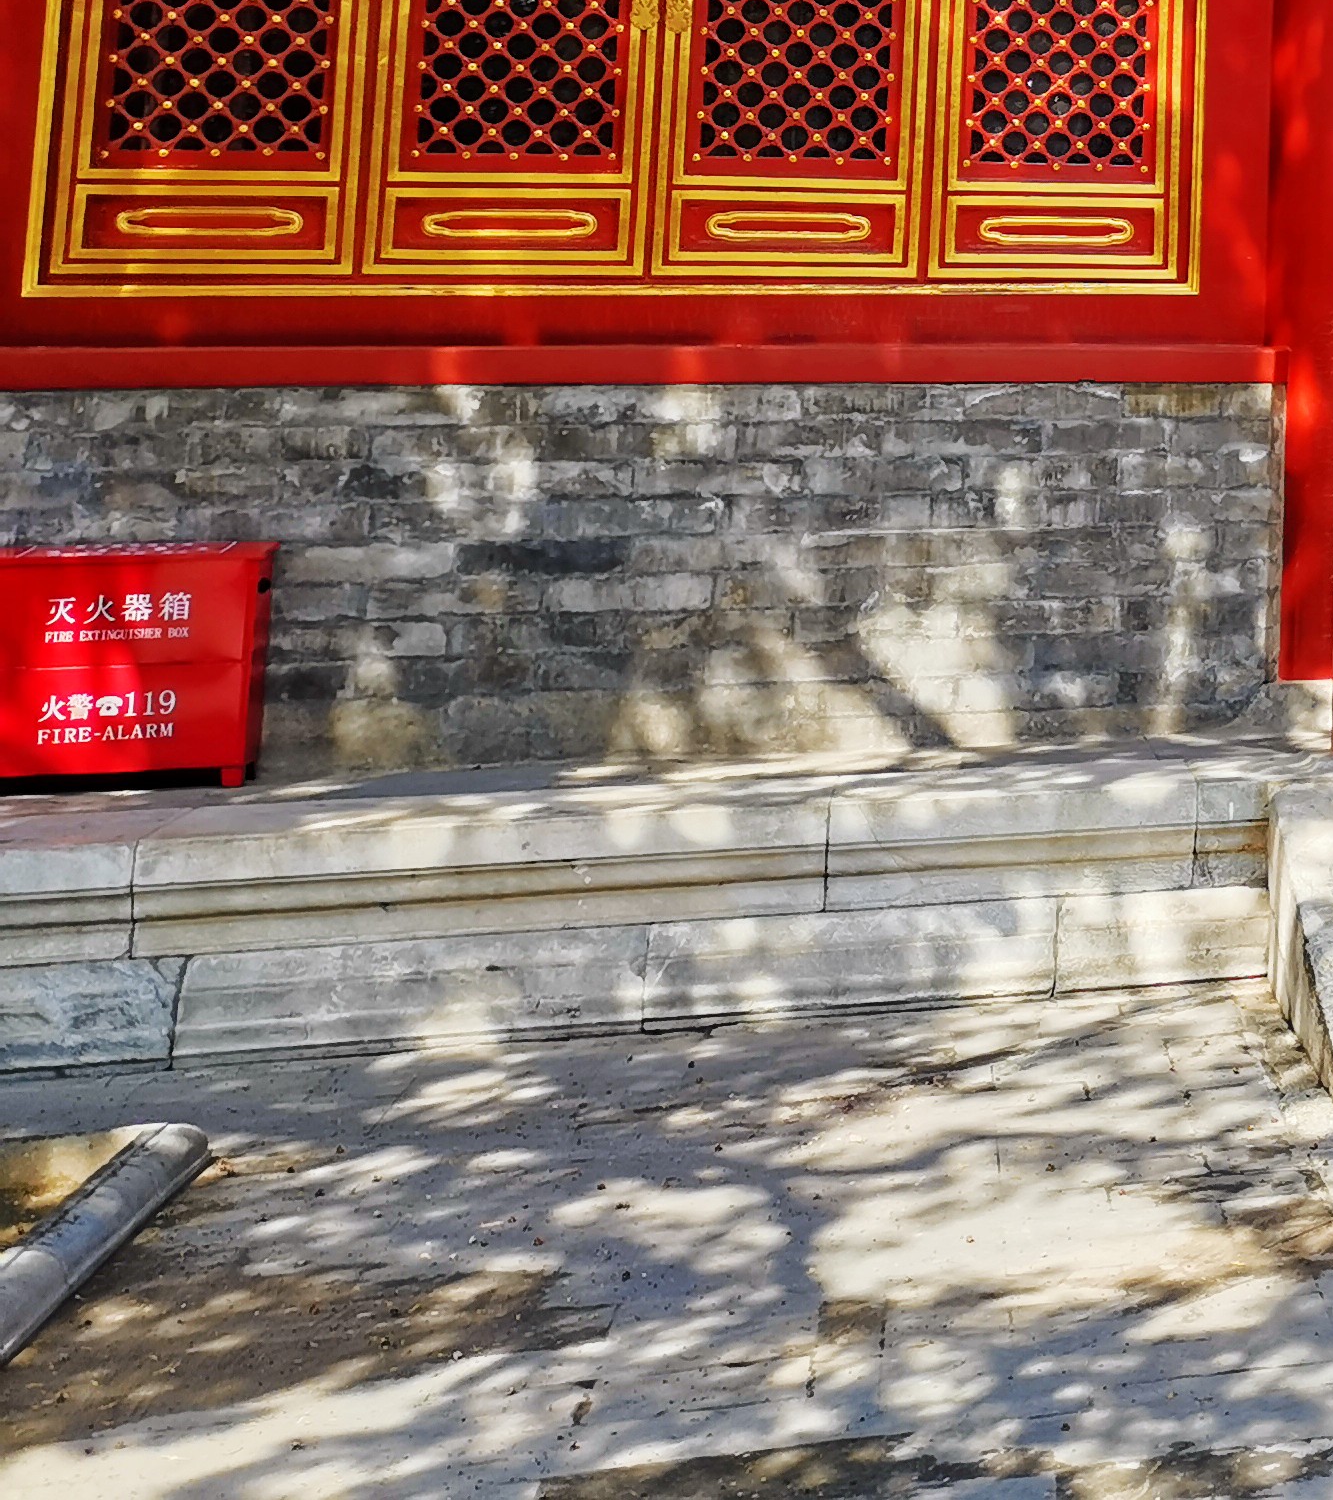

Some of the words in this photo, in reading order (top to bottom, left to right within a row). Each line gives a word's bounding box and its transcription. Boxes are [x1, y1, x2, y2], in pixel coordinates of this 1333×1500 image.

[45, 591, 194, 626] 灭火器箱
[44, 630, 74, 643] FIRE
[78, 627, 163, 642] EXTINGUISHER
[167, 626, 190, 639] BOX
[124, 689, 177, 718] 119
[37, 722, 175, 745] FIRE-ALARM
